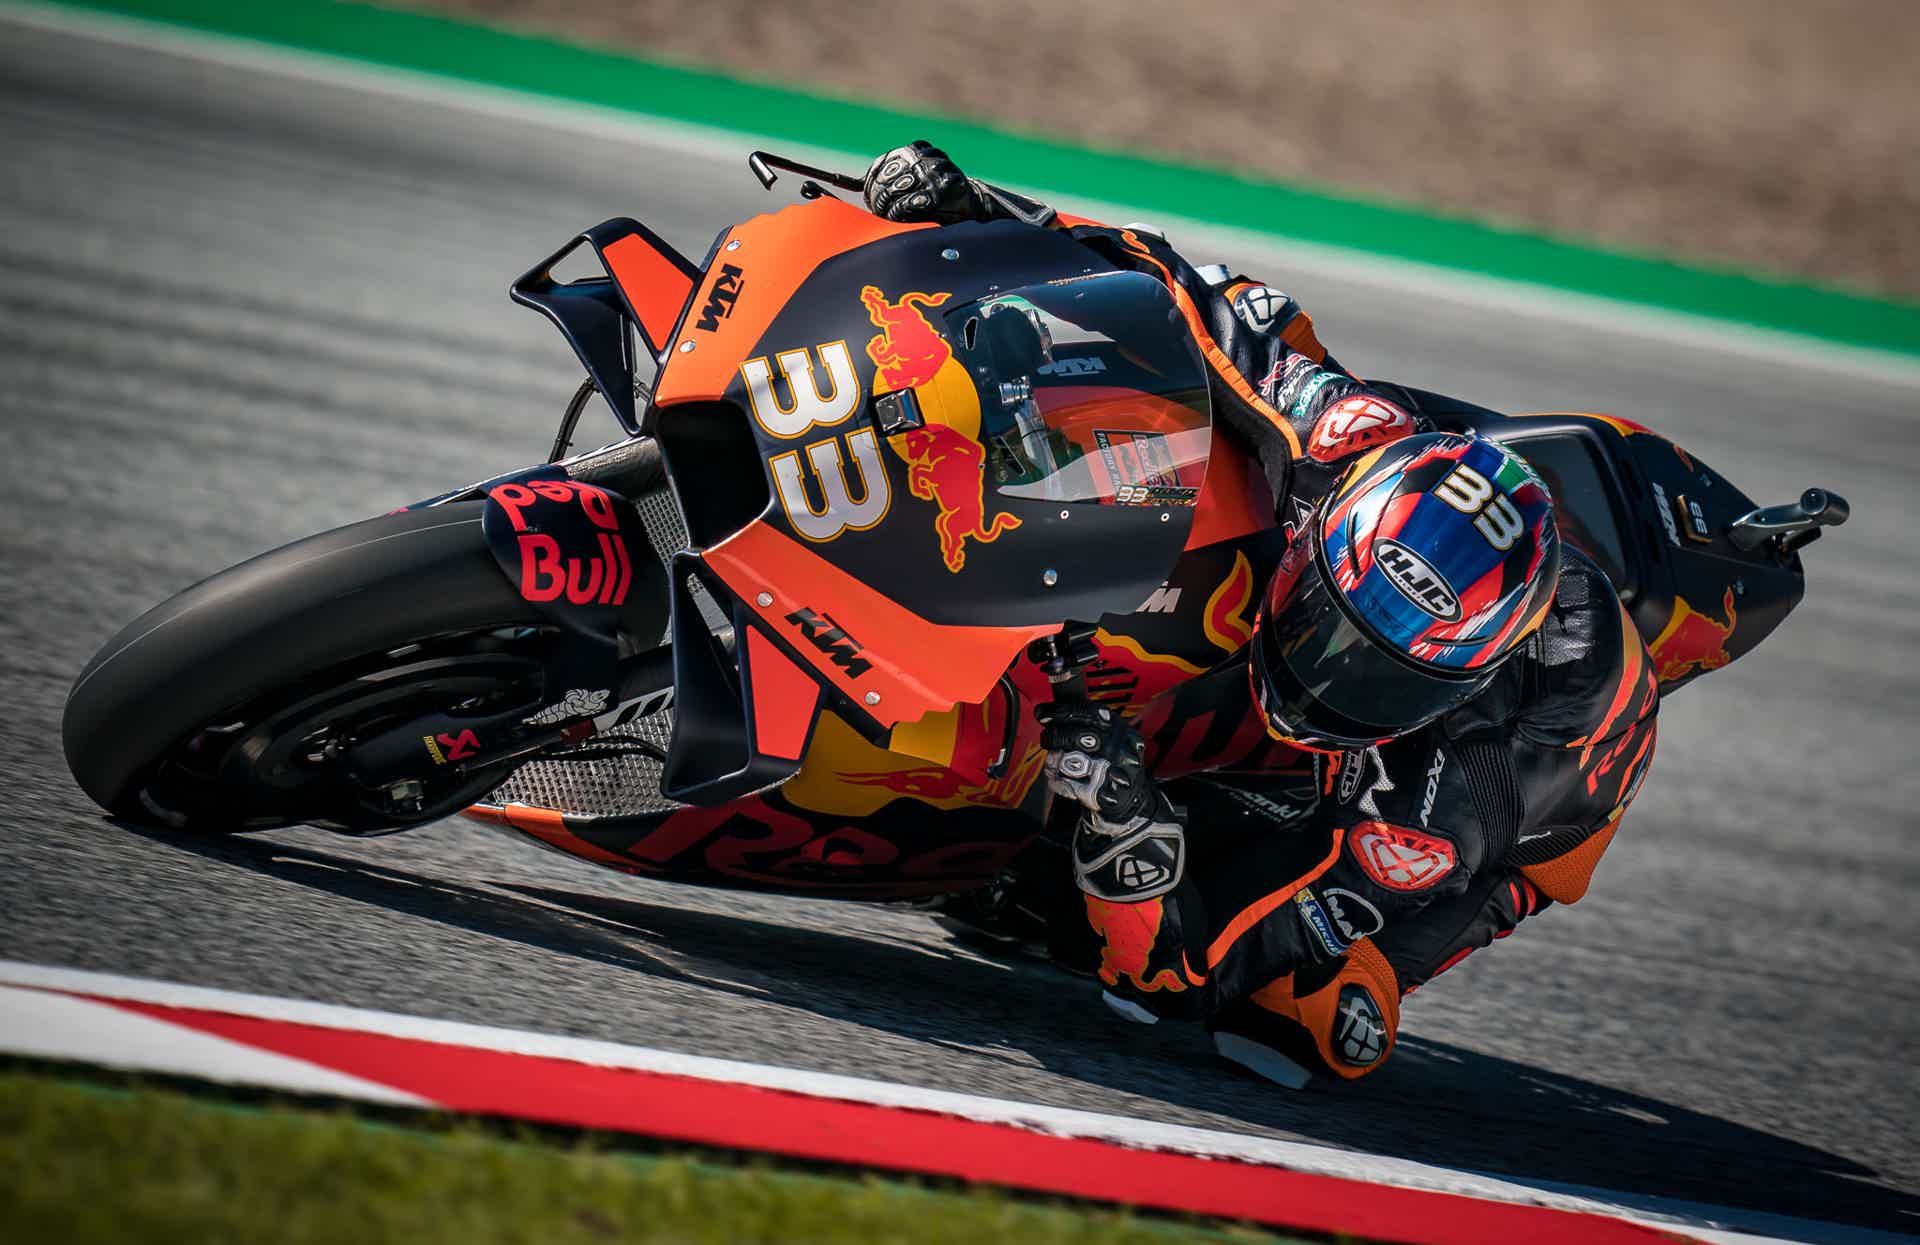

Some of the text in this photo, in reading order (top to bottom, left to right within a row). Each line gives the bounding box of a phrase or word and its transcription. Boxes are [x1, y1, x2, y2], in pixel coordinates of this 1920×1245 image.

[695, 263, 745, 333] KTM
[739, 339, 892, 543] 33
[489, 480, 620, 532] Red
[1433, 463, 1525, 552] 33
[516, 532, 633, 607] Bull
[1379, 547, 1455, 612] HJC
[783, 606, 874, 680] KTM
[1420, 748, 1447, 829] IXON
